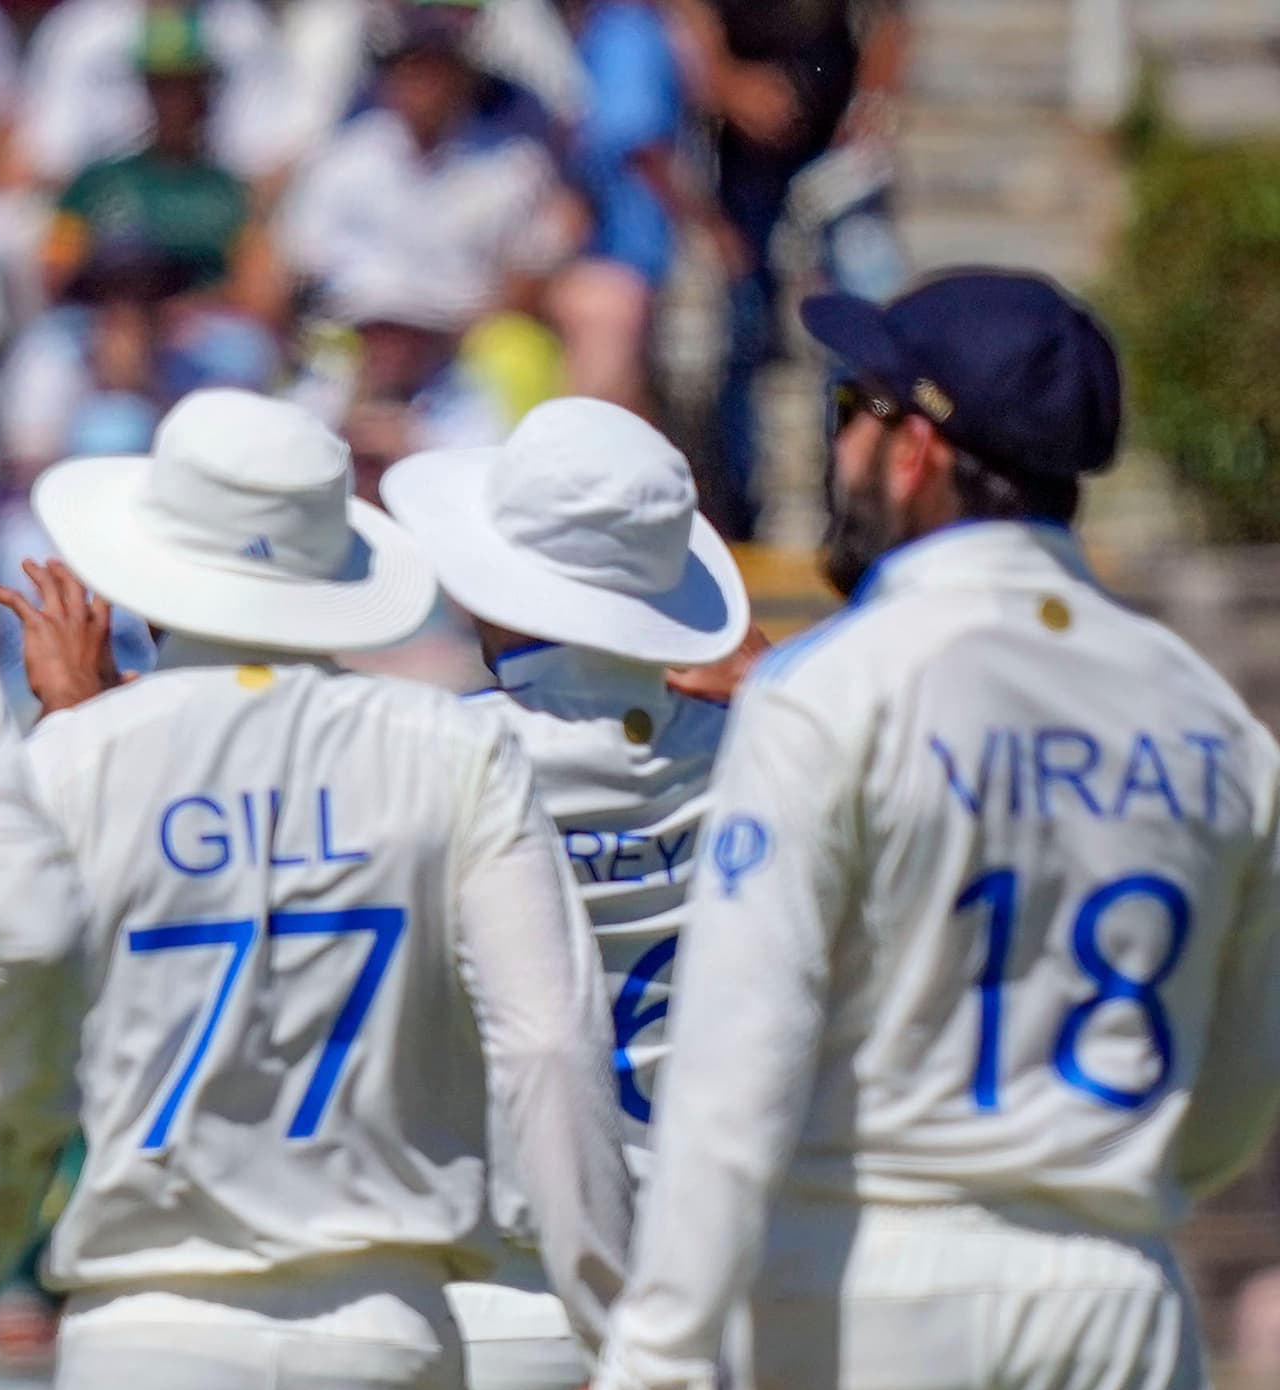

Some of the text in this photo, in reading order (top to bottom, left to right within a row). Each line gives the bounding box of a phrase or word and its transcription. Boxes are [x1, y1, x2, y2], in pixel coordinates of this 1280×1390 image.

[159, 788, 371, 879] GILL
[930, 728, 1228, 823] VIRAT
[127, 905, 408, 1150] 77
[955, 866, 1194, 1114] 18
